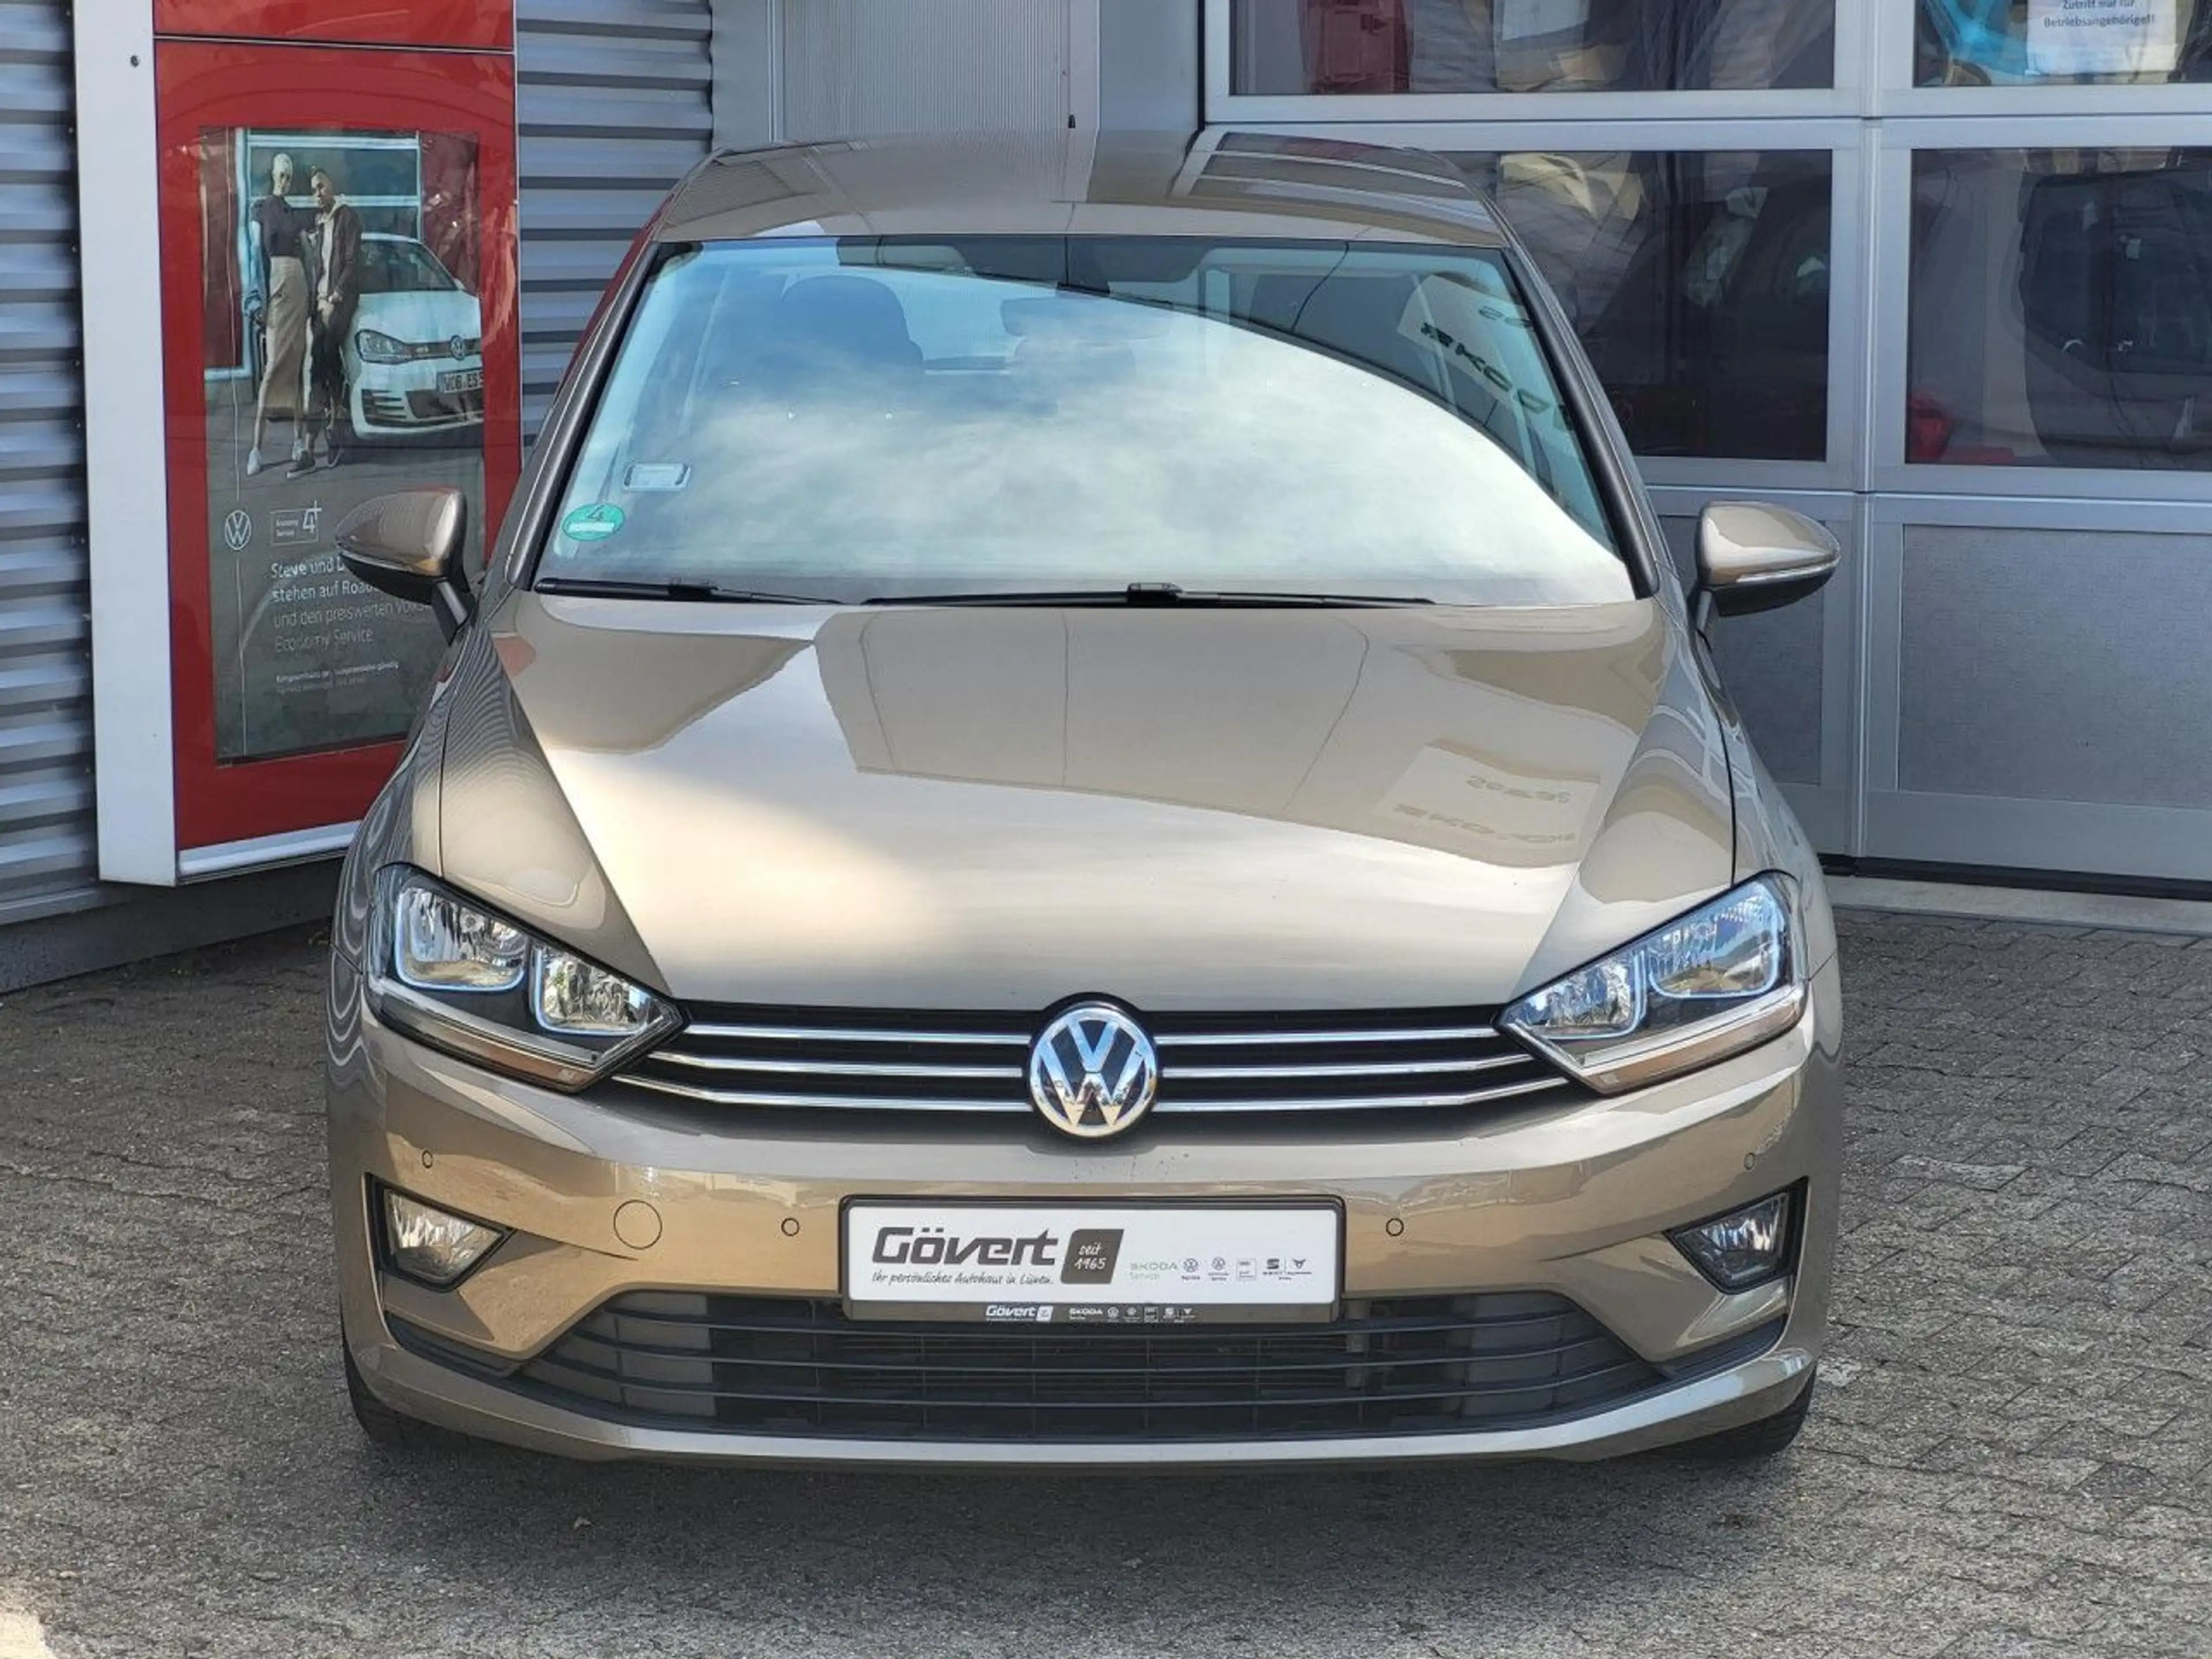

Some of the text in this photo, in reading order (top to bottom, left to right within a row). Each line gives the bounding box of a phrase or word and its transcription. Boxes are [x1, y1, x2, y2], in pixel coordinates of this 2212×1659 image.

[310, 556, 334, 575] und
[272, 585, 316, 603] stehen
[320, 581, 339, 598] auf
[274, 611, 297, 630] und
[300, 609, 323, 625] den
[326, 603, 393, 624] preiswerten
[333, 628, 374, 645] Service
[872, 1226, 1059, 1266] Gövert
[1074, 1257, 1107, 1270] 1965
[872, 1270, 888, 1284] Ihr
[889, 1271, 952, 1286] persönliches
[1006, 1272, 1017, 1285] in
[985, 1305, 1036, 1317] Gövert
